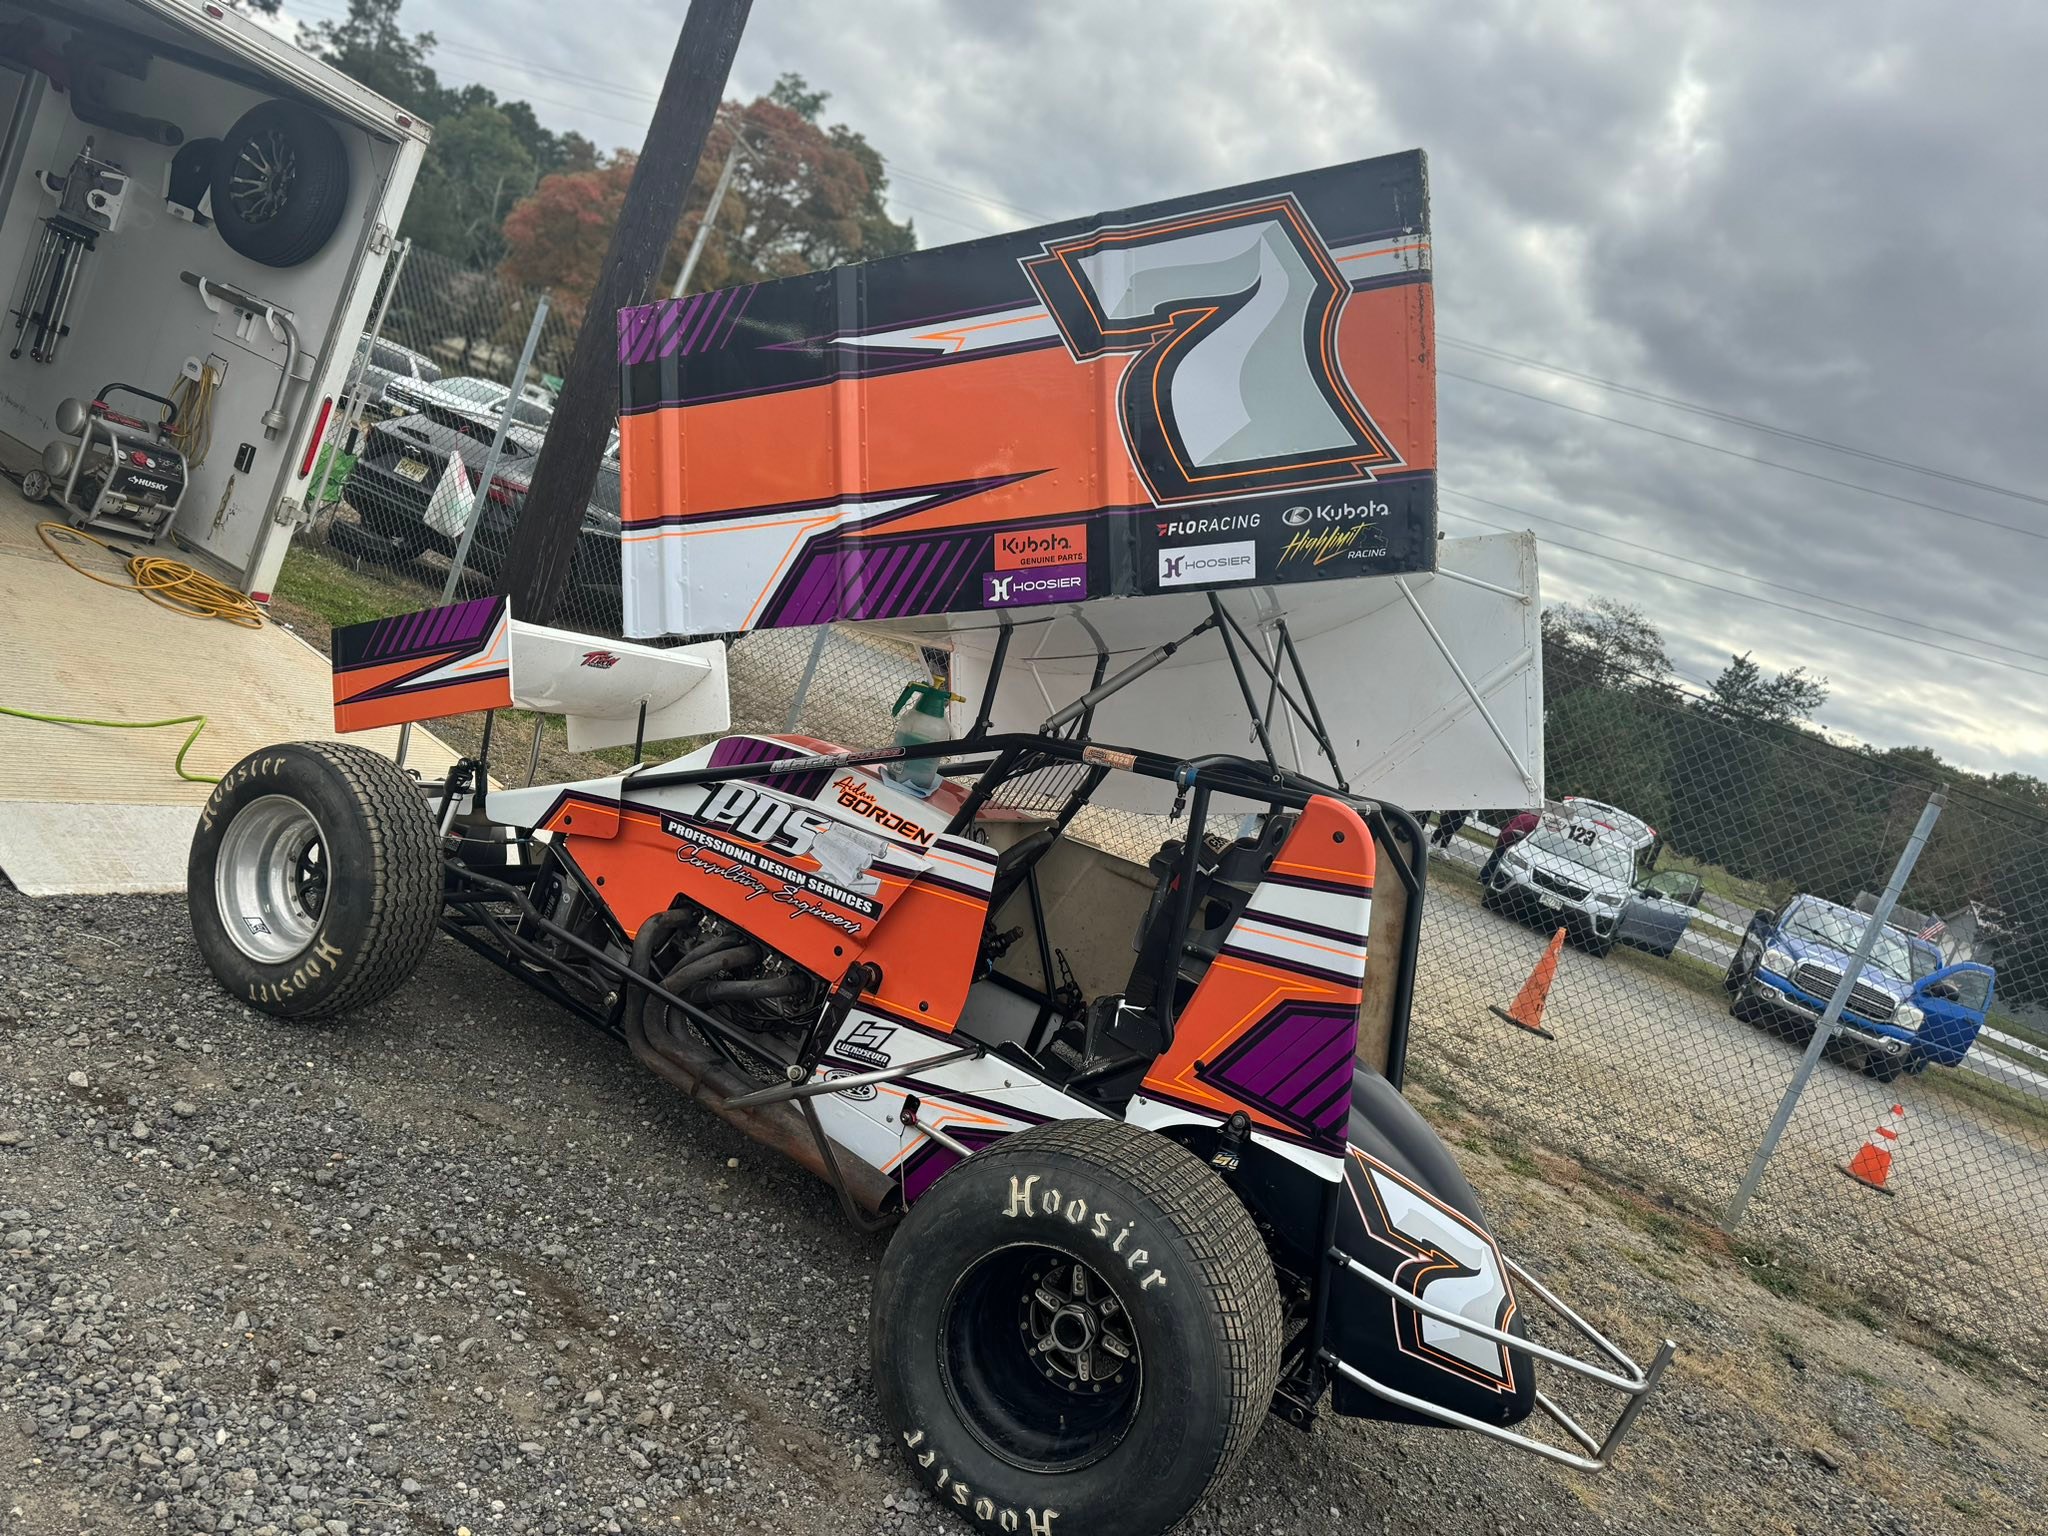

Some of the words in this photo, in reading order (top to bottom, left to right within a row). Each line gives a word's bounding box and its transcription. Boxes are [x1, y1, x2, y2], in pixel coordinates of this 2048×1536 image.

[1052, 203, 1388, 485] 7
[138, 478, 168, 491] HUSKY
[1013, 577, 1081, 592] HOOSIER
[1020, 555, 1055, 565] GENUINE
[1058, 553, 1083, 561] PARTS
[1185, 555, 1251, 570] HOOSIER
[1347, 548, 1386, 559] RACING
[201, 754, 287, 832] Hoosier
[696, 782, 832, 857] PDS
[831, 776, 877, 802] Aidan
[837, 791, 935, 846] BORDEN
[667, 821, 757, 866] PROFESSIONAL
[758, 857, 806, 886] DESIGN
[807, 876, 873, 914] SERVICES
[1567, 825, 1597, 847] 123
[677, 843, 769, 900] Consulting
[772, 884, 862, 934] Engineers
[249, 928, 343, 1007] Hoosier
[1001, 1174, 1167, 1291] Hoosier
[1356, 1152, 1512, 1388] 7
